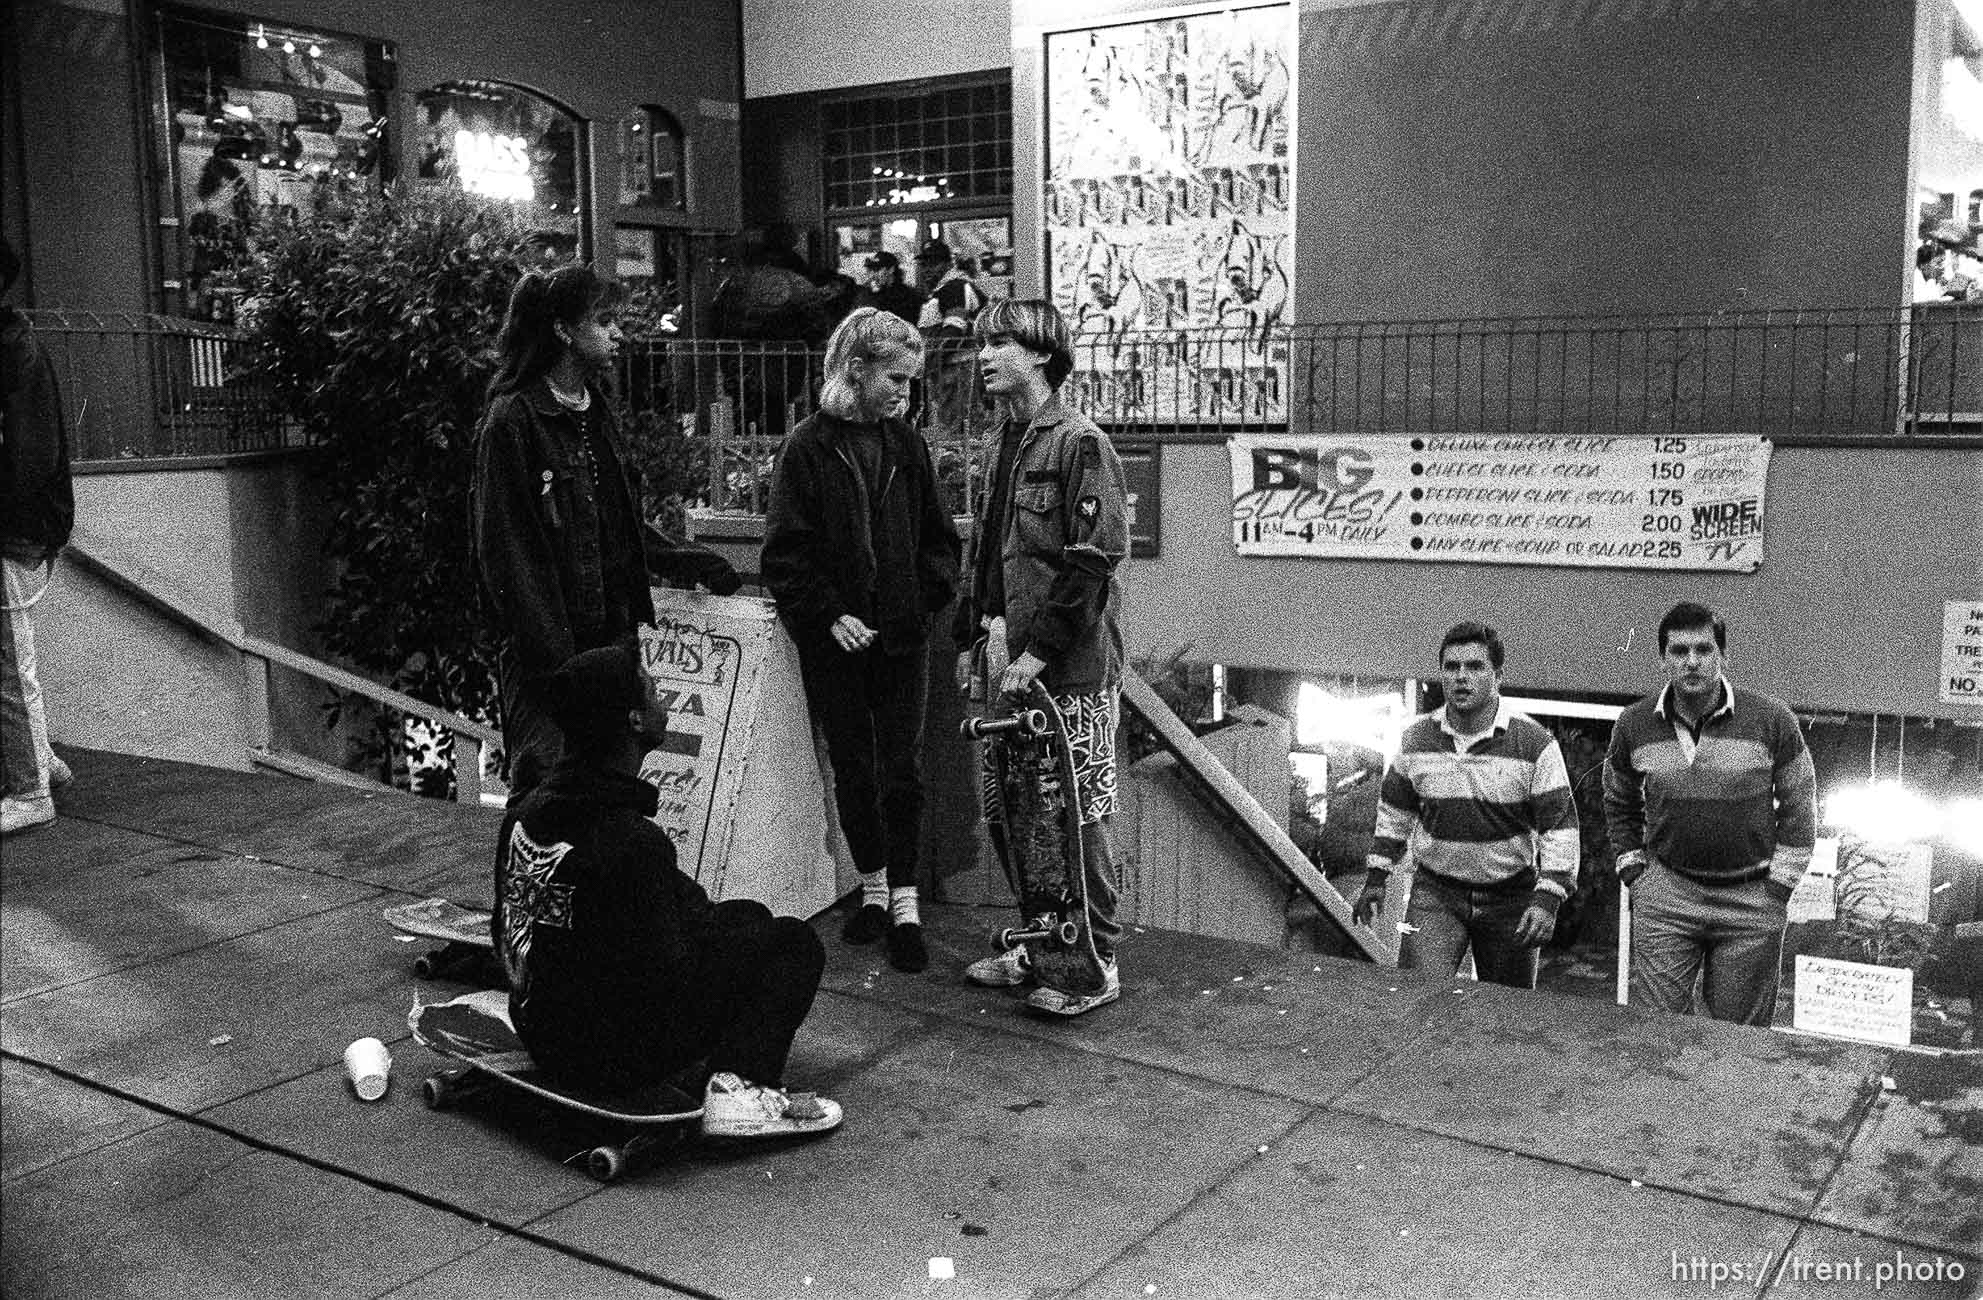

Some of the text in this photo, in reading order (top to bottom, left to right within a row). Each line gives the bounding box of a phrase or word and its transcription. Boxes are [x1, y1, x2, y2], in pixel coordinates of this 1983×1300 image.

[1563, 437, 1617, 453] SLICE
[1653, 437, 1687, 454] 1.25
[1252, 448, 1375, 494] BIG
[1425, 462, 1488, 478] CHEESE
[1490, 462, 1536, 478] SLICE
[1553, 463, 1601, 478] SODA
[1425, 486, 1520, 503] PEPPERONI
[1523, 488, 1574, 504] SLICE
[1586, 489, 1636, 505] SODA
[1648, 488, 1684, 506] 1.75
[1233, 488, 1403, 523] SLICES!
[1691, 500, 1757, 525] WIDE
[1424, 511, 1484, 528] COMBO
[1486, 512, 1535, 529] SLICE
[1545, 514, 1592, 530] SODA
[1690, 517, 1762, 541] SCREEN
[1340, 524, 1387, 541] DAILY
[1426, 537, 1460, 552] ANY
[1460, 538, 1504, 554] SLICE
[1514, 539, 1560, 556] SOUP
[1566, 541, 1584, 556] OR
[1588, 541, 1642, 558] SALAD
[1705, 541, 1747, 560] TV
[1949, 677, 1976, 692] NO
